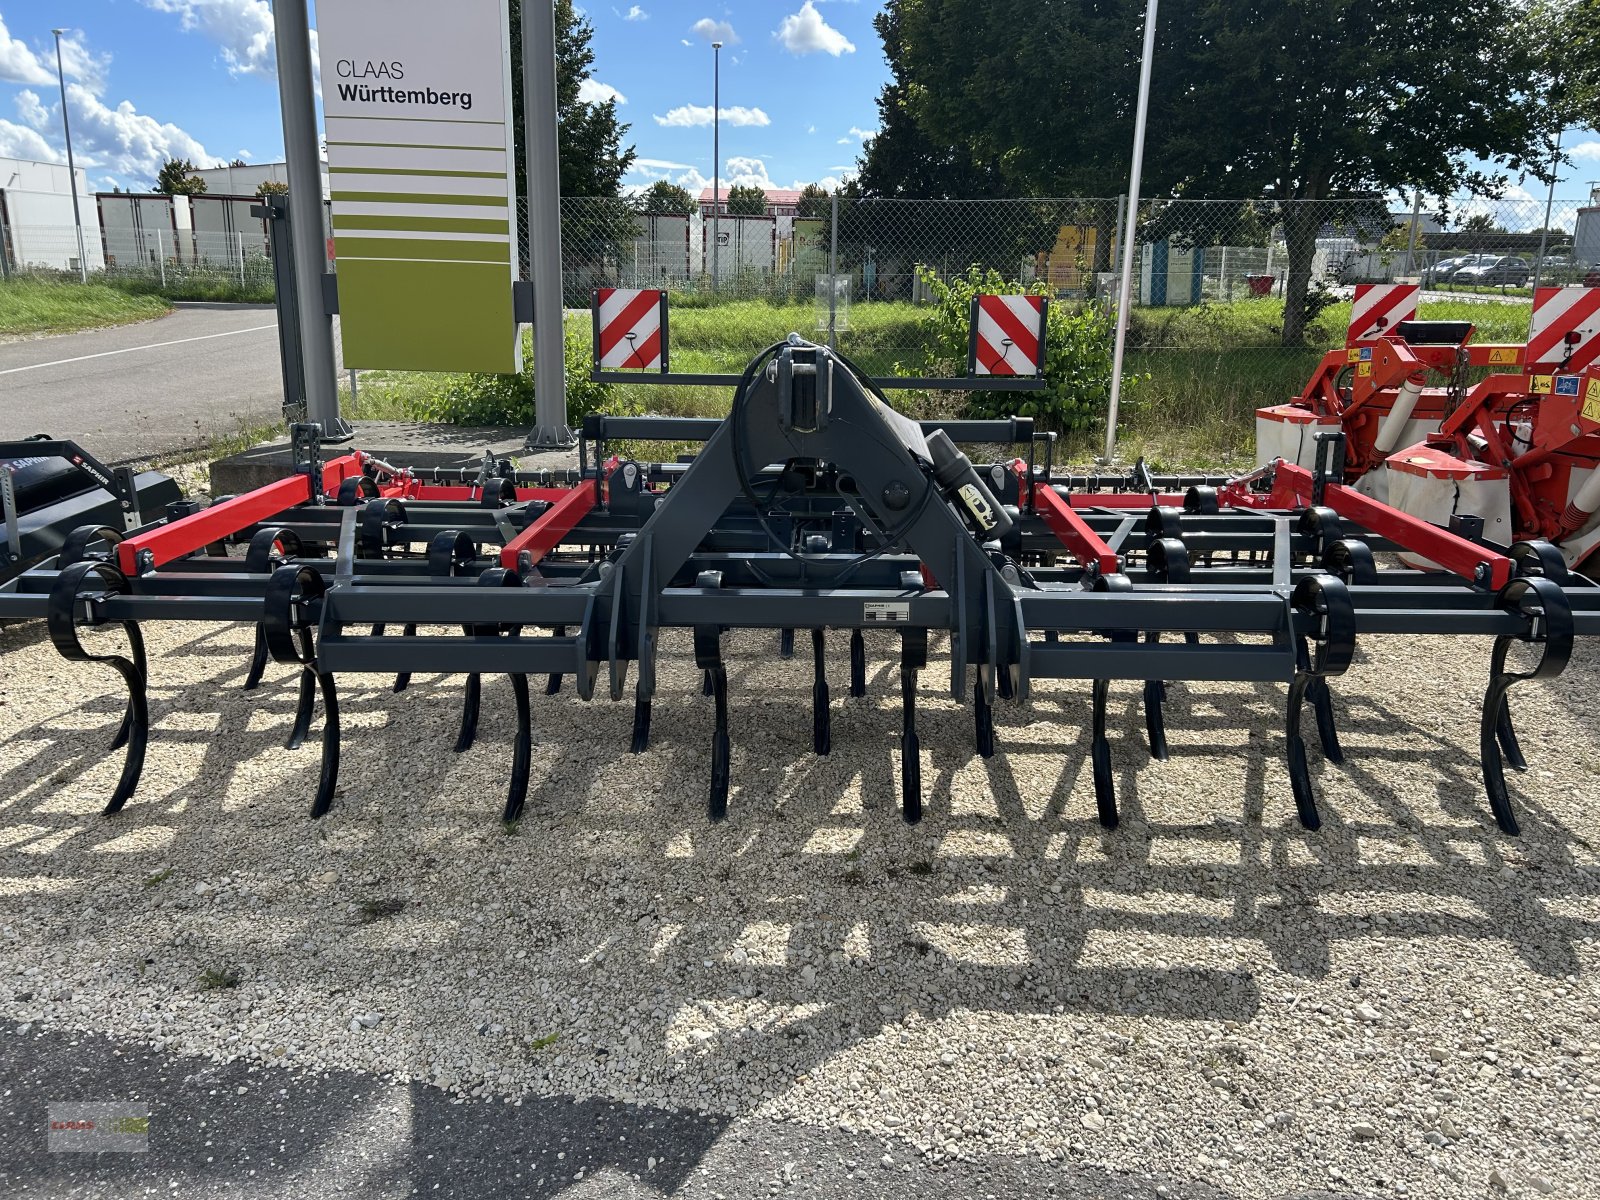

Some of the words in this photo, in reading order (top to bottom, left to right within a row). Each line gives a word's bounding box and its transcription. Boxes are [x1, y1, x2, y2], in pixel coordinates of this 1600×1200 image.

[336, 59, 404, 80] CLAAS
[337, 83, 472, 110] Württemberg
[81, 462, 109, 485] SAPHIR
